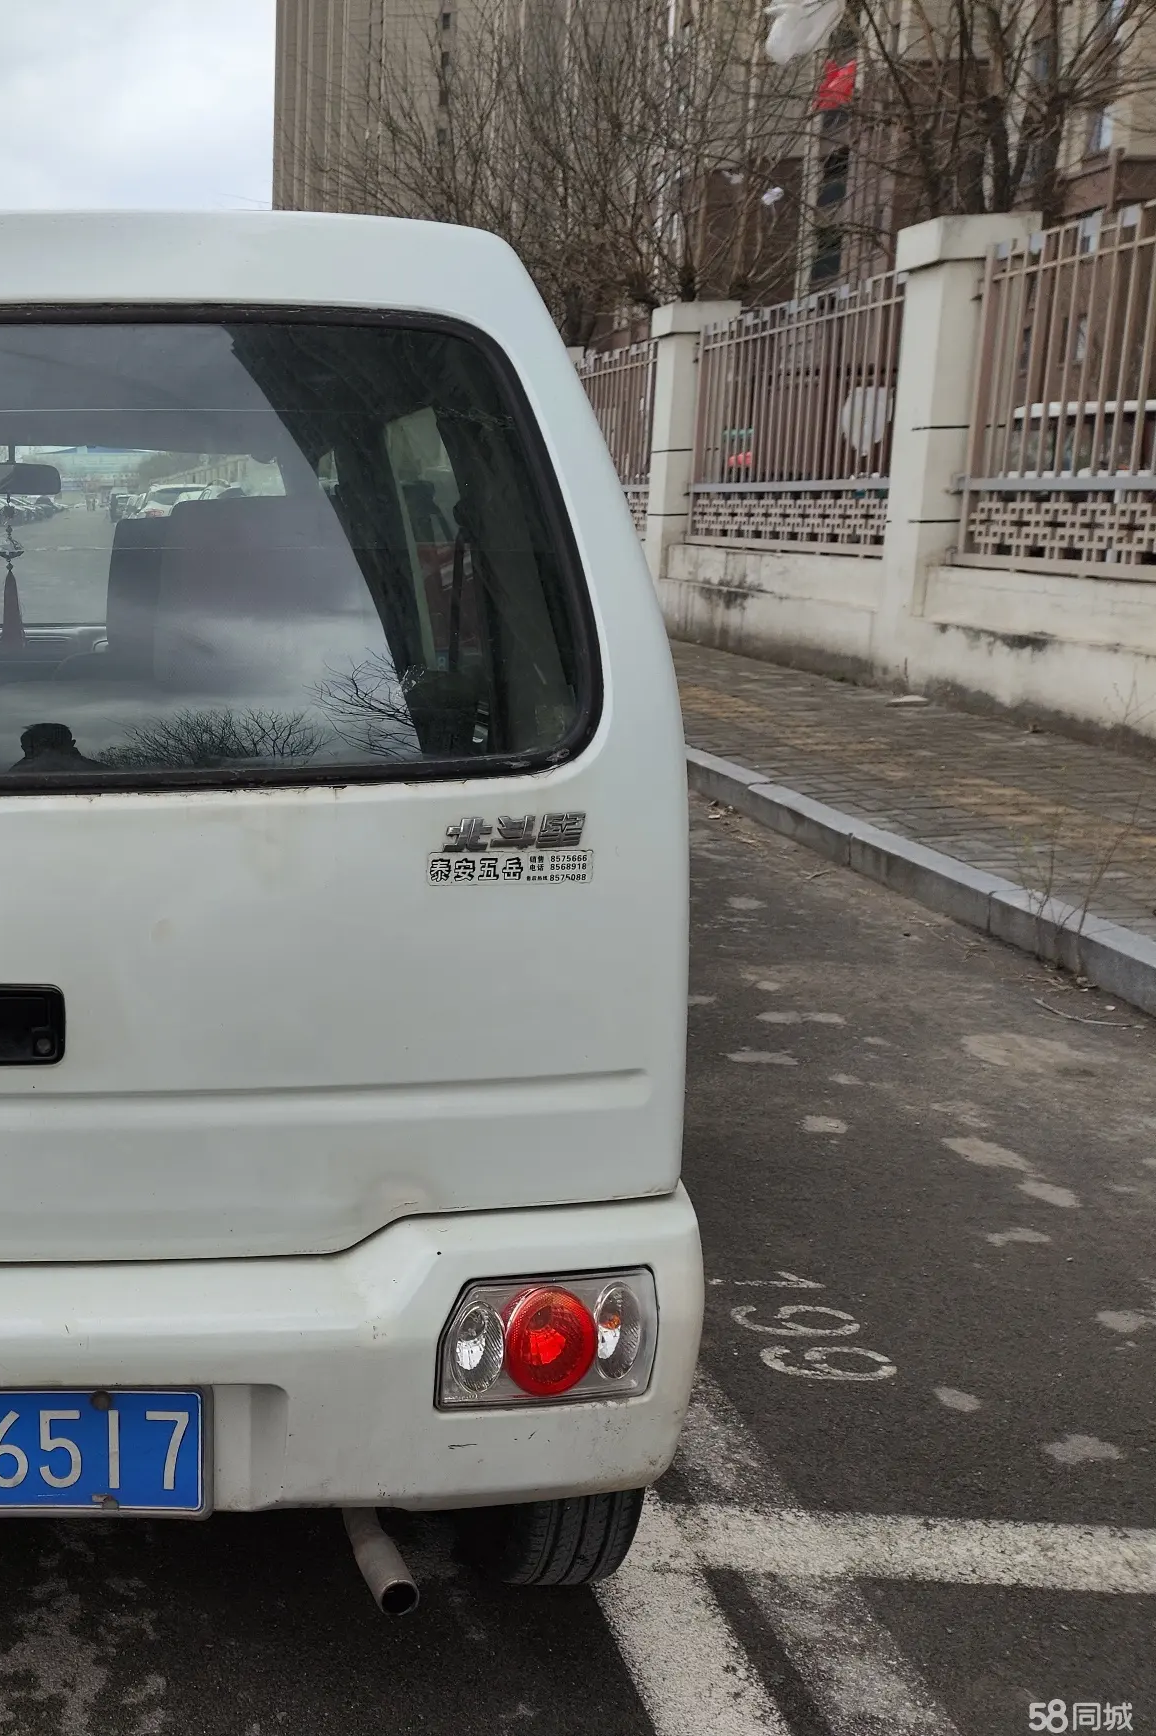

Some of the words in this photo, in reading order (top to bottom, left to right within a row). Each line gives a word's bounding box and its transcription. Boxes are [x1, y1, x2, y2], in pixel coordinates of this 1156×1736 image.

[442, 812, 587, 852] 北斗星
[550, 854, 588, 863] 8575666
[429, 857, 524, 882] 泰安五岳
[550, 863, 587, 871] 8568918
[549, 873, 587, 882] 8575088
